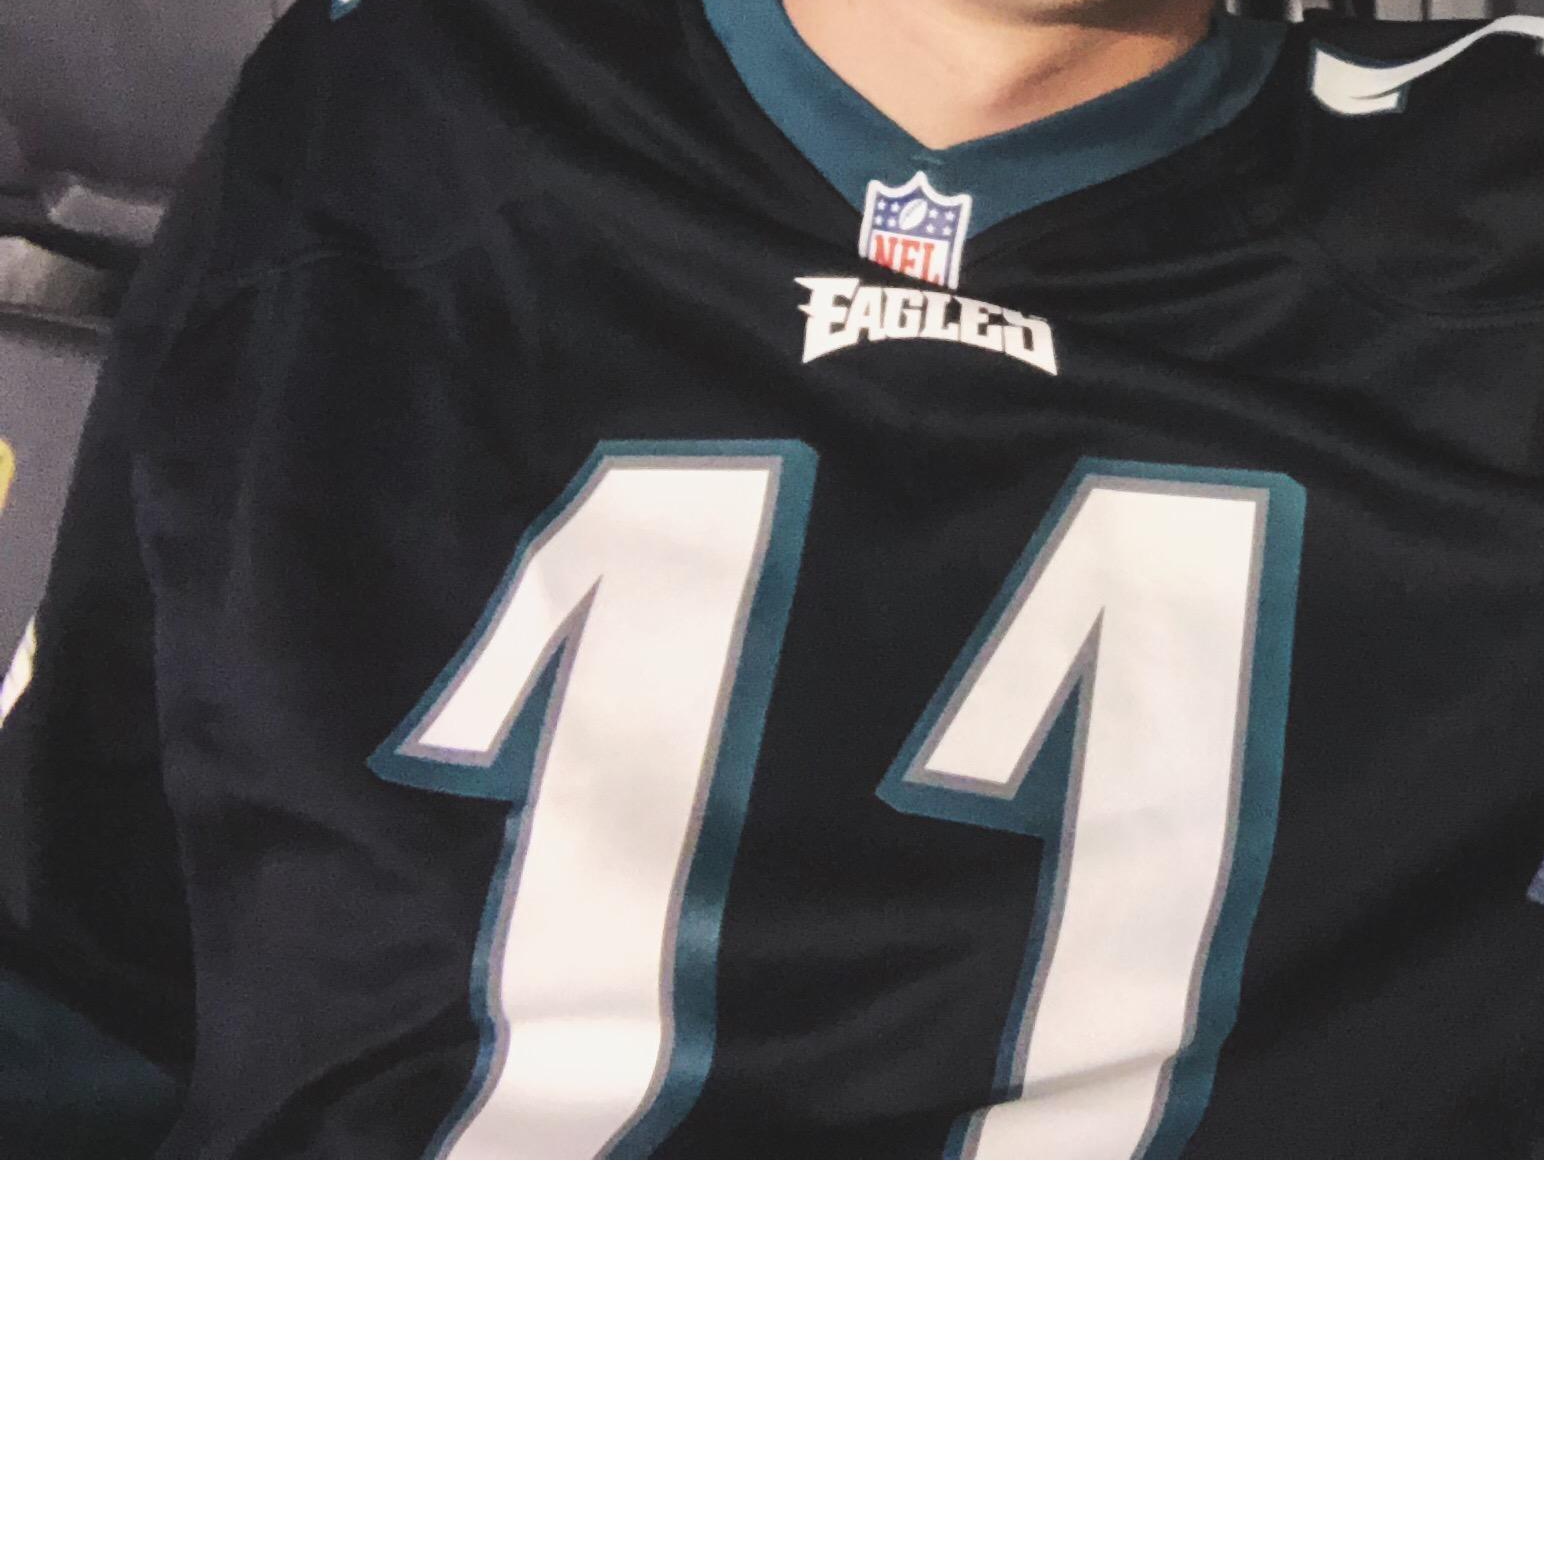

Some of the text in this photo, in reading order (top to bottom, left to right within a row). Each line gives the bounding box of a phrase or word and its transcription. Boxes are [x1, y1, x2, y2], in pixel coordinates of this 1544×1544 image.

[873, 234, 944, 287] NFL
[795, 276, 1058, 376] EAGLES
[366, 437, 1307, 1159] 11
